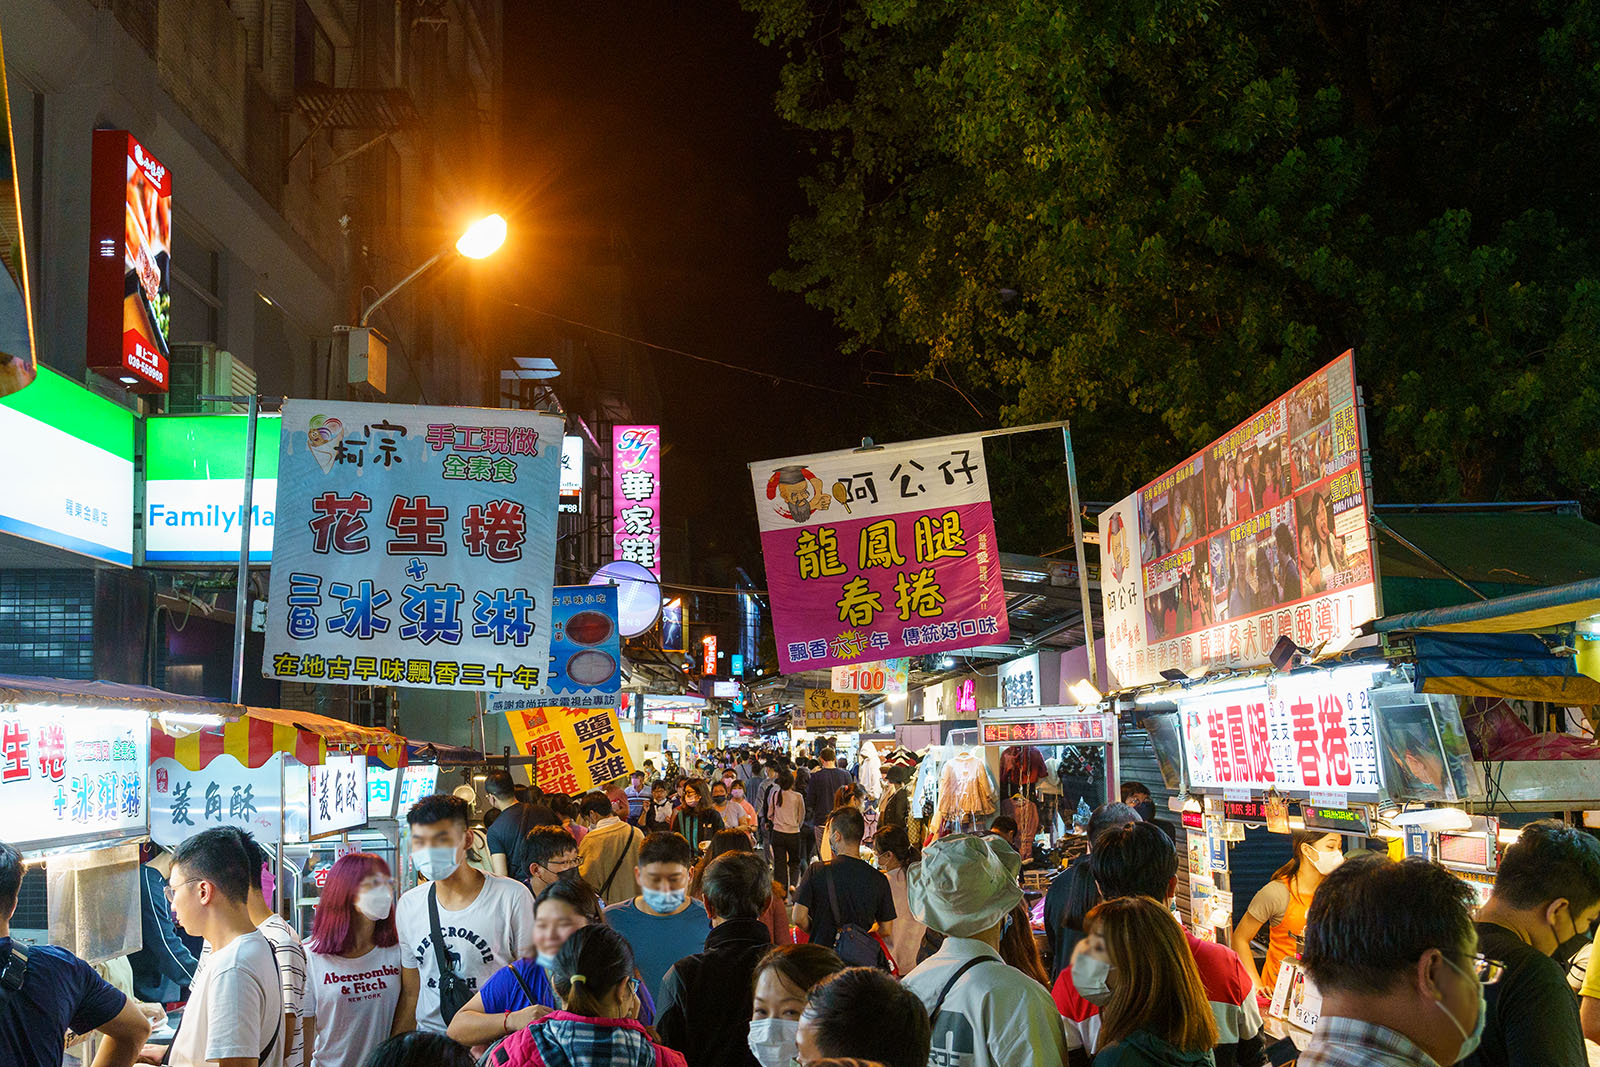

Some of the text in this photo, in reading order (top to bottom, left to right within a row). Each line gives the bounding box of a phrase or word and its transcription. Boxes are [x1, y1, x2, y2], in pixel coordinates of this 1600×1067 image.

[425, 424, 538, 456] 手工現做
[442, 455, 517, 484] 全素食
[838, 450, 978, 504] 阿公仔
[1330, 468, 1361, 503] 壹周刊
[309, 492, 526, 562] 花生捲
[794, 510, 968, 580] 龍鳳腿
[287, 572, 535, 647] 三色 冰淇淋
[837, 567, 946, 628] 春捲
[1107, 582, 1137, 612] 阿公仔
[788, 616, 998, 663] 飄香六十年 傳統好口味
[273, 653, 540, 691] 在地古早味飄香三十年
[849, 670, 885, 691] 100
[1, 720, 66, 783] 生捲
[525, 730, 581, 794] 麻辣雞
[573, 711, 629, 785] 鹽水雞
[1207, 703, 1276, 783] 龍鳳腿
[1290, 694, 1352, 787] 春捲
[71, 771, 140, 824] 冰淇淋
[170, 781, 257, 826] 菱角酥
[320, 769, 358, 820] 菱角酥
[415, 926, 494, 965] ABECROMBIE
[323, 964, 399, 985] Abercrombie
[341, 978, 387, 995] & Fitch
[364, 993, 381, 1001] YORK
